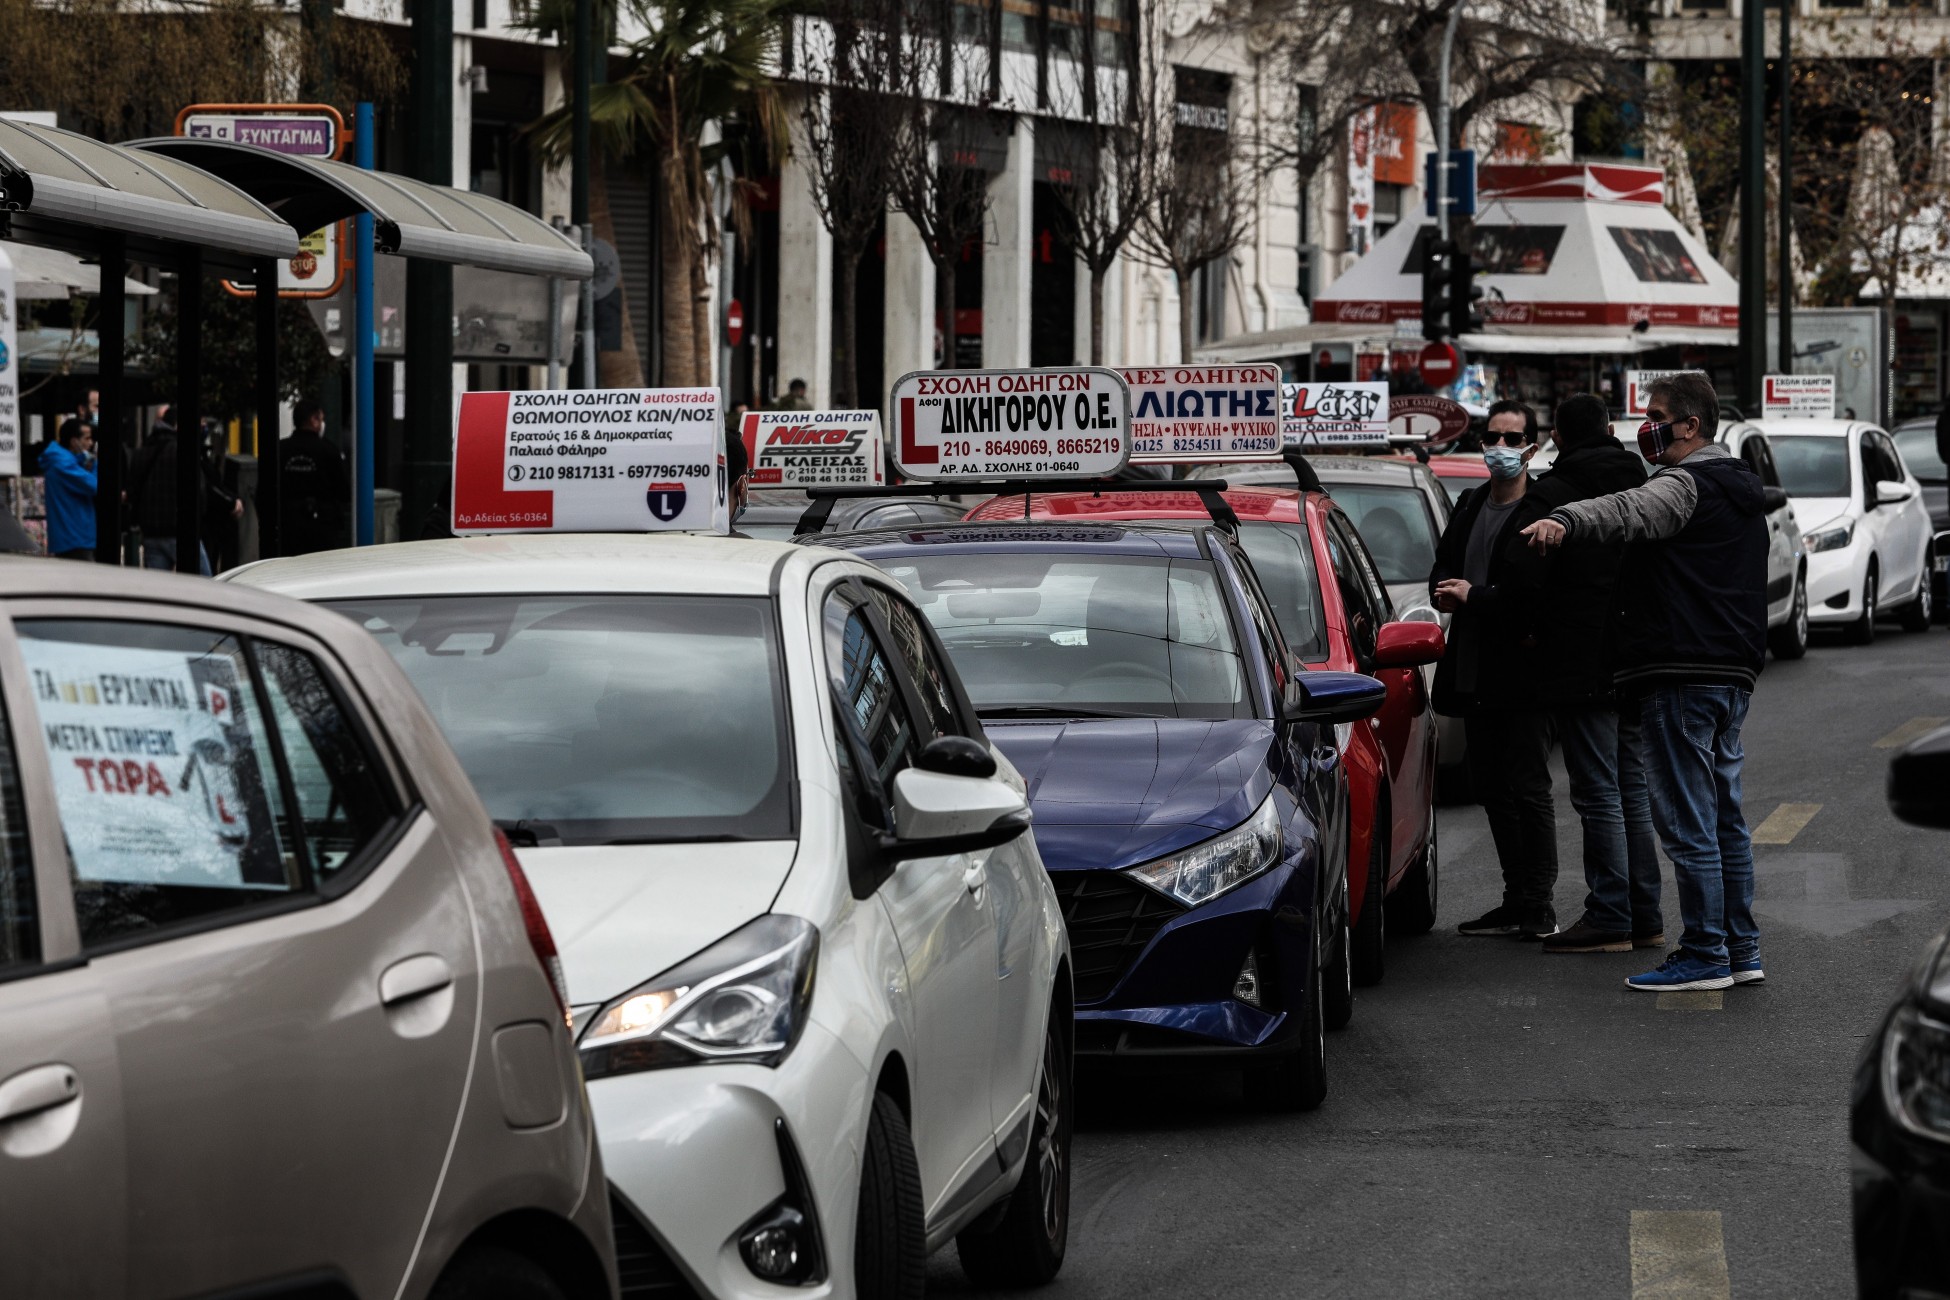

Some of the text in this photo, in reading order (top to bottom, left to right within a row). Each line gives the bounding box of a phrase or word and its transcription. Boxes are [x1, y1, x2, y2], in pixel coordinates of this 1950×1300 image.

[240, 129, 323, 144] ΣΥΝΤΑΓΜΑ
[1338, 302, 1382, 320] Coca-Cola
[1124, 368, 1276, 384] ΛΕΣ ΟΔΗΓΩΝ
[918, 374, 1090, 395] ΣΧΟΛΗ ΟΔΗΓΩΝ
[514, 392, 715, 406] ΣΧΟΛΗ ΟΔΗΓΩΝ autostrada
[1131, 390, 1276, 418] ΛΙΩΤΗΣ
[1412, 398, 1456, 412] ΟΔΗΓΩΝ
[512, 408, 715, 424] ΘΩΜΟΠΟΥΛΟΣ ΚΩΝ/ΝΟΣ
[762, 413, 873, 424] ΣΧΟΛΗ ΟΔΗΓΩΝ
[919, 392, 1118, 434] ΑΦΟΙ ΔΙΚΗΓΟΡΟΥ Ο.Ε.
[1131, 422, 1276, 438] ΤΗΣΙΑ ΚΥΨΕΛΗ ΨΥΧΙΚΟ
[1284, 423, 1362, 432] ΛΗ ΟΔΗΓΩΝ
[510, 430, 673, 443] Ερατούς 16 & Δημοκρατίας
[1174, 438, 1222, 451] 8254511
[1232, 438, 1276, 450] 6744250
[509, 445, 607, 458] Παλαιό Φάληρο
[944, 440, 970, 457] 210
[985, 439, 1052, 458] 8649069,
[1057, 438, 1120, 454] 8665219
[760, 456, 866, 466] Π. ΚΛΕΙΣΑΣ
[940, 460, 1080, 474] ΑΡ. ΑΔ. ΣΧΟΛΗΣ 01-0640
[530, 467, 554, 480] 210
[558, 466, 615, 480] 9817131
[628, 464, 710, 478] 6977967490
[661, 494, 673, 516] L
[458, 512, 548, 524] Αρ.Αδείας 56-0364
[33, 668, 59, 700] ΤΑ
[46, 724, 104, 751] ΜΕΤΡΑ
[74, 758, 172, 796] ΤΩΡΑ
